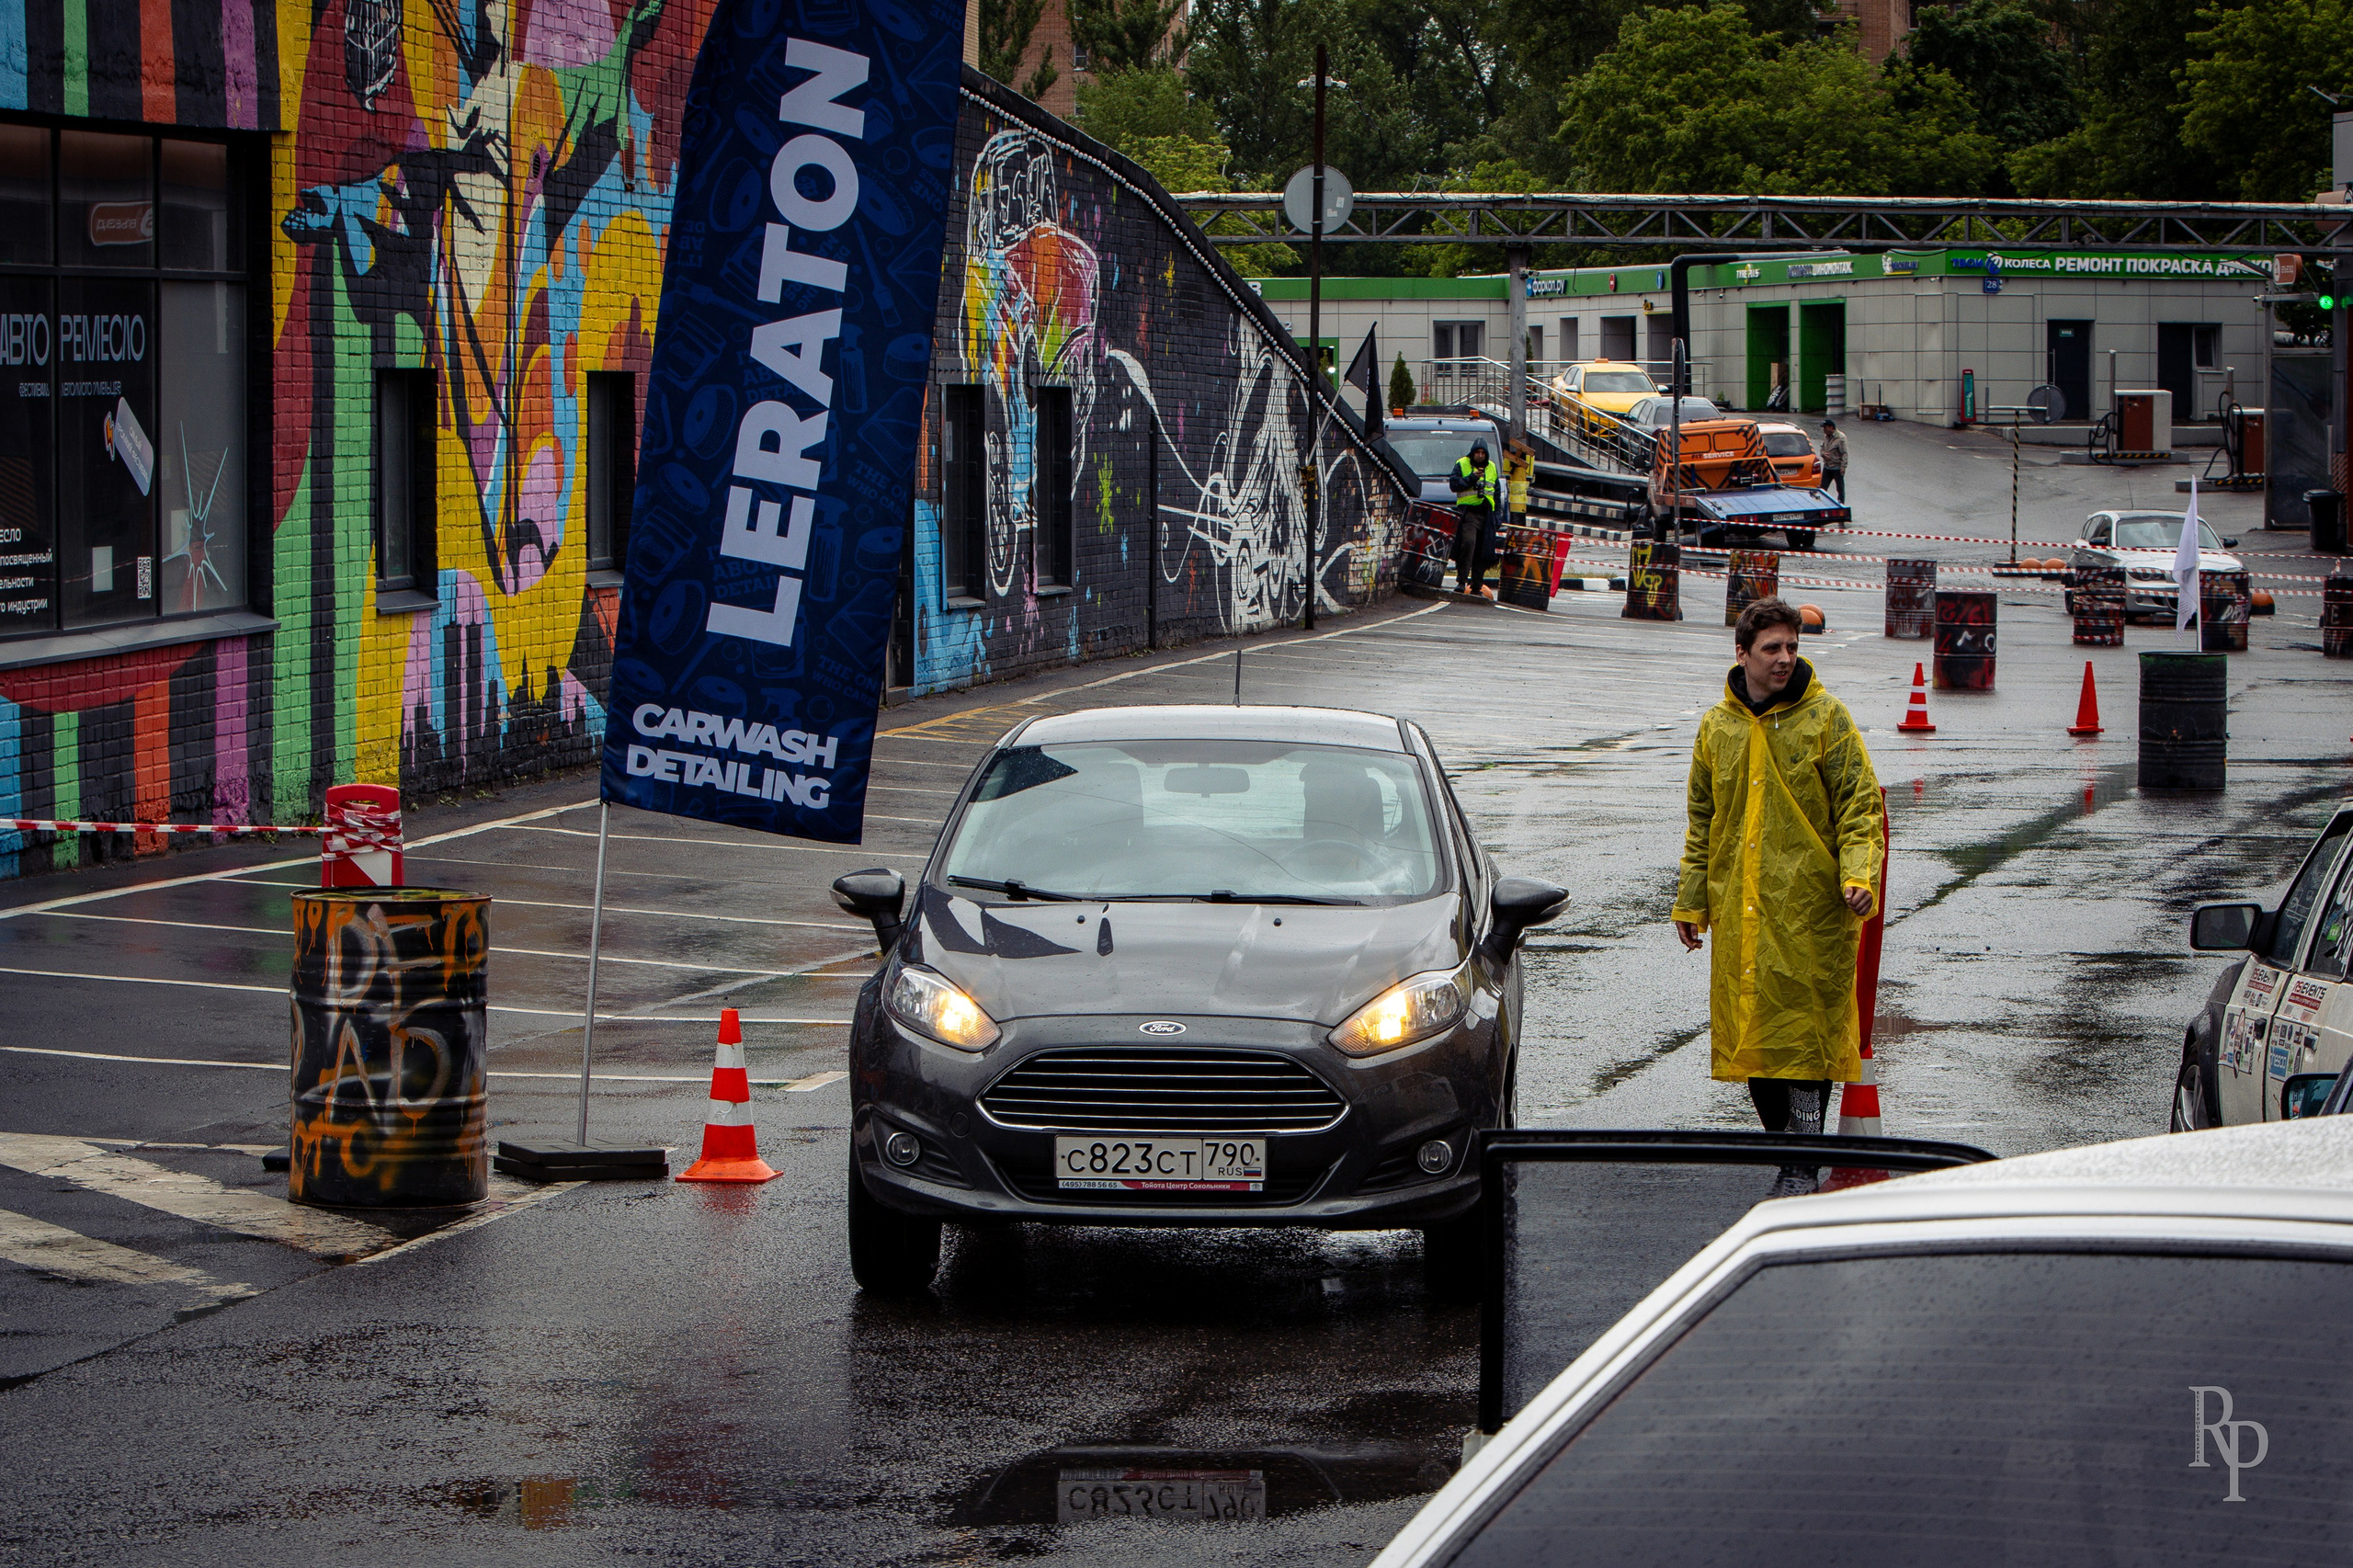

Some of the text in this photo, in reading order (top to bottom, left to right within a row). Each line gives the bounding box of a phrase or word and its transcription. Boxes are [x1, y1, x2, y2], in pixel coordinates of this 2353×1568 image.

[2005, 258, 2051, 269] КОЛЕСА
[2055, 256, 2123, 273] РЕМОНТ
[2126, 258, 2213, 274] ПОКРАСКА
[1986, 280, 1997, 290] 28
[0, 313, 145, 366] АВТО РЕМЕСЛО
[706, 37, 870, 647] LERATON
[1702, 451, 1734, 460] SERVICE
[7, 598, 48, 615] индустрии
[632, 703, 838, 769] CARWASH
[626, 744, 832, 809] DETAILING
[2292, 981, 2327, 1000] RS EVENTS
[1149, 1023, 1176, 1032] Ford
[1205, 1142, 1255, 1166] 790
[1218, 1166, 1243, 1176] RUS
[1166, 1182, 1188, 1190] Центр
